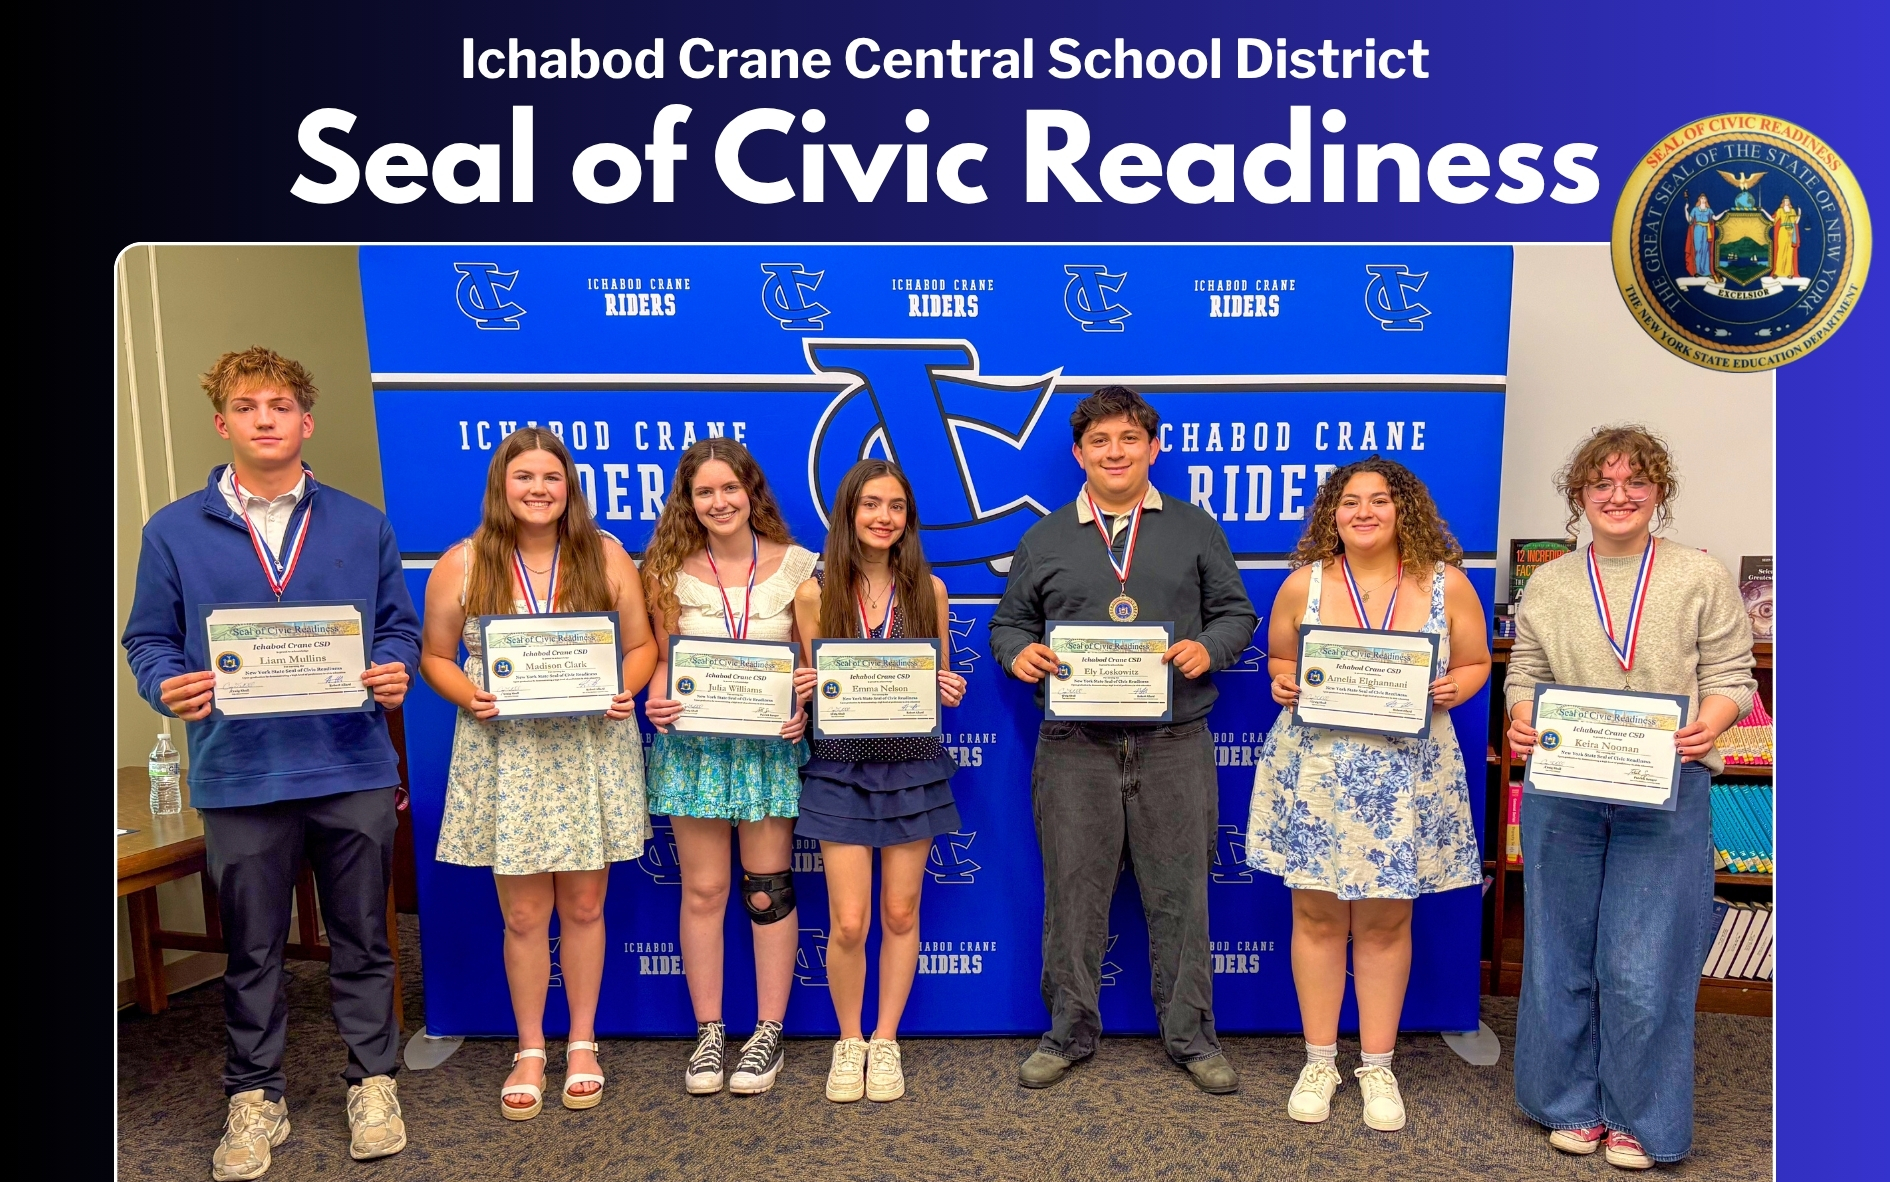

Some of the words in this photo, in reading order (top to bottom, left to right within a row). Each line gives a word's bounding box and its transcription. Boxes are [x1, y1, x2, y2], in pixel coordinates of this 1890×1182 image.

[587, 278, 643, 290] ICHABOD
[650, 278, 691, 290] CRANE
[892, 278, 947, 291] ICHABOD
[953, 279, 994, 291] CRANE
[1194, 279, 1249, 292] ICHABOD
[1255, 279, 1296, 291] CRANE
[604, 293, 676, 316] RIDERS
[908, 293, 979, 318] RIDERS
[1209, 294, 1280, 318] RIDERS
[1160, 422, 1290, 453] CHABOD
[1315, 420, 1426, 451] CRANE
[1516, 550, 1525, 562] 12
[233, 628, 253, 636] Seal
[255, 626, 266, 635] of
[267, 626, 291, 635] Civic
[294, 625, 339, 634] Readiness
[525, 635, 534, 643] of
[558, 633, 595, 642] Readiness
[253, 642, 286, 650] Ichabod
[287, 641, 312, 649] Crane
[260, 656, 287, 665] Liam
[289, 654, 327, 663] Mullins
[1340, 649, 1349, 657] of
[1351, 650, 1371, 658] Civic
[1373, 652, 1411, 661] Readiness
[525, 662, 562, 670] Madison
[564, 661, 587, 669] Clark
[740, 660, 776, 668] Readiness
[1084, 668, 1097, 677] Ely
[1327, 675, 1356, 684] Amelia
[708, 684, 727, 692] Julia
[729, 685, 763, 693] Williams
[1559, 708, 1577, 717] Seal
[1579, 710, 1588, 718] of
[1589, 711, 1612, 721] Civic
[1614, 714, 1656, 725] Readiness
[1573, 726, 1603, 735] Ichabod
[1604, 729, 1627, 737] Crane
[959, 733, 998, 744] CRANE
[1575, 739, 1599, 749] Keira
[1601, 742, 1639, 753] Noonan
[624, 942, 674, 953] ICHABOD
[960, 941, 997, 952] CRANE
[1237, 941, 1274, 951] CRANE
[918, 954, 982, 975] RIDERS
